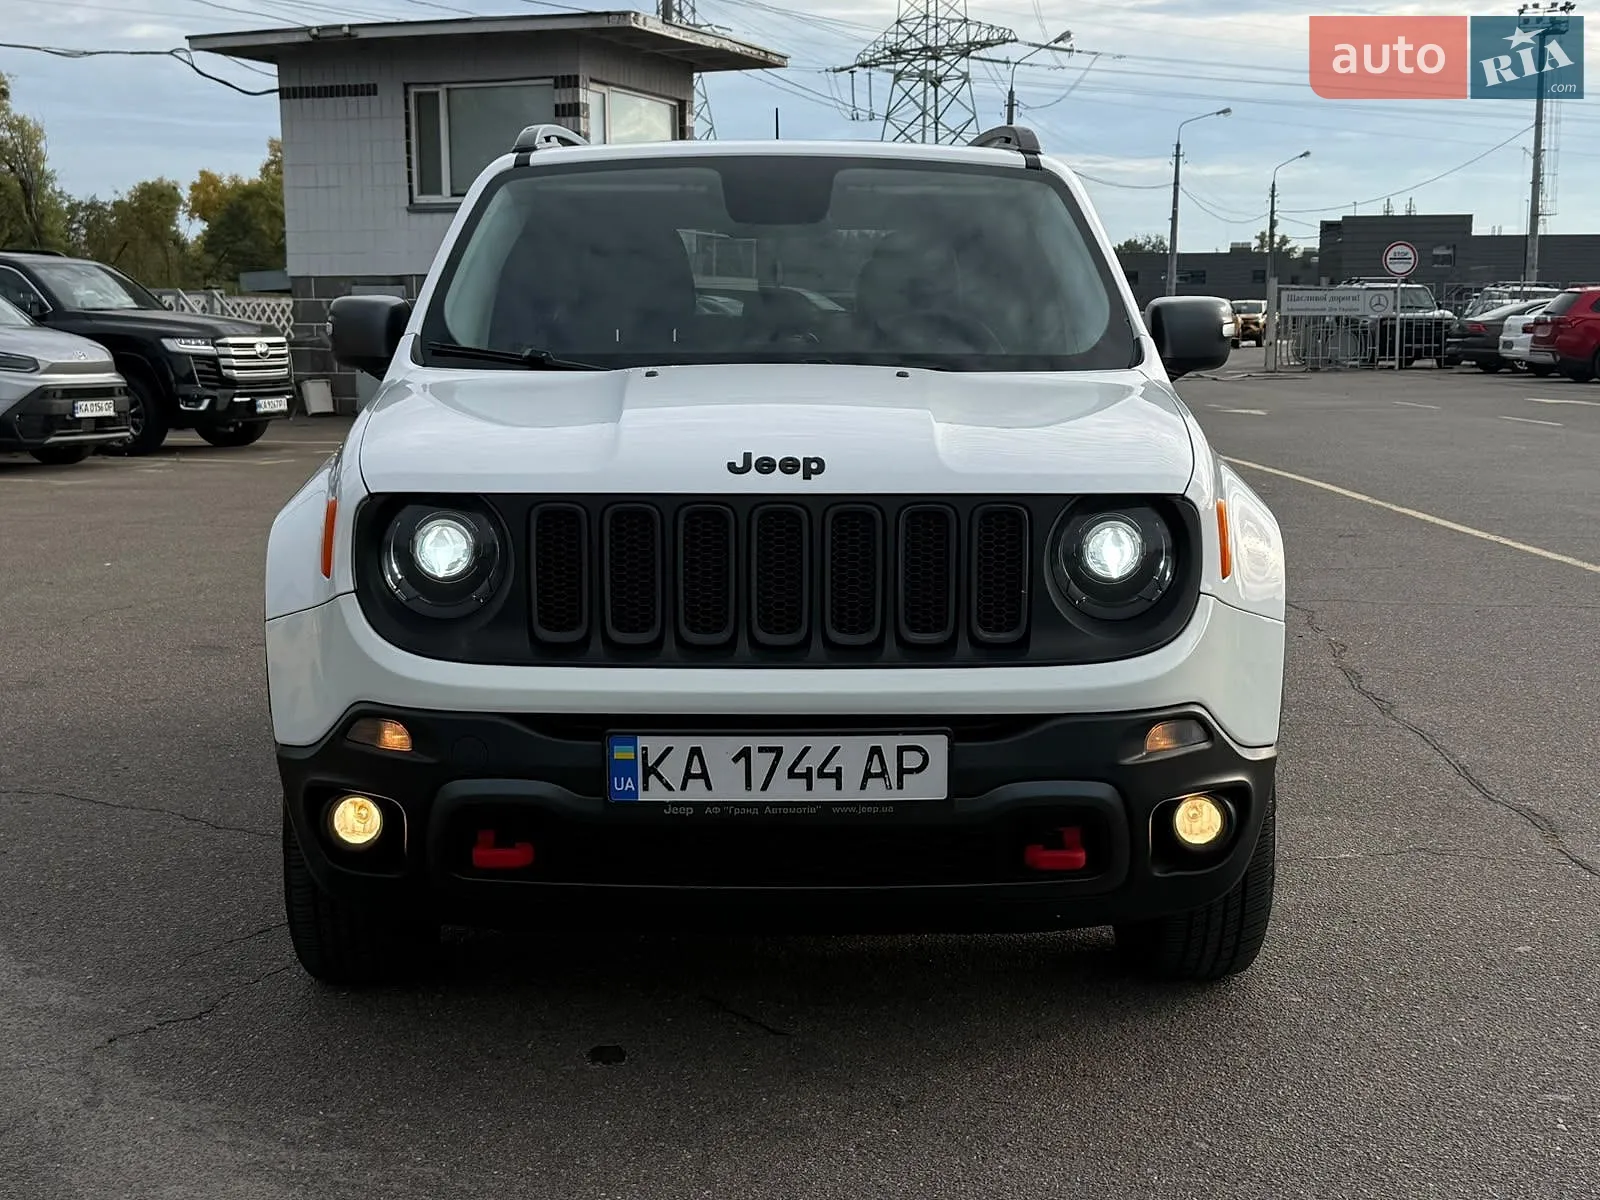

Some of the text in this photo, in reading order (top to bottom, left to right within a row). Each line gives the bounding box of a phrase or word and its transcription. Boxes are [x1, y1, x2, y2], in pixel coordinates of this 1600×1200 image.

[727, 451, 825, 480] Jeep
[640, 744, 930, 792] KA 1744 AP
[614, 776, 635, 791] UA
[663, 804, 694, 817] Jeep
[831, 804, 895, 815] www.jeep.ua
